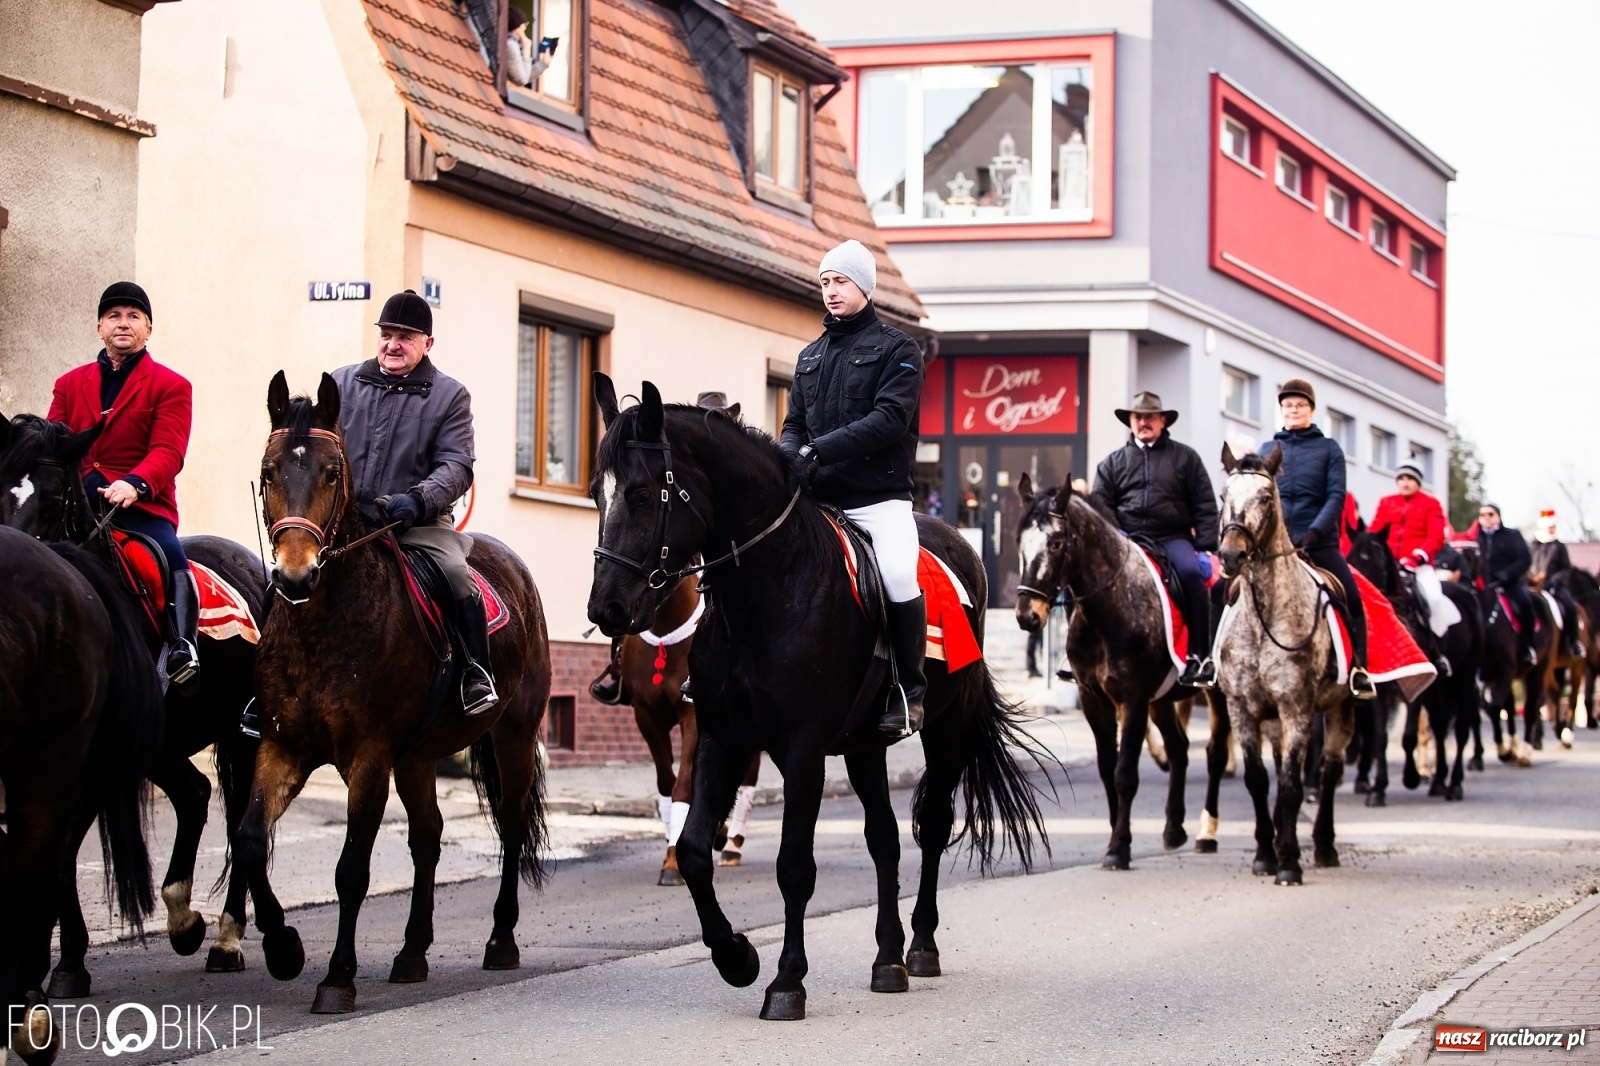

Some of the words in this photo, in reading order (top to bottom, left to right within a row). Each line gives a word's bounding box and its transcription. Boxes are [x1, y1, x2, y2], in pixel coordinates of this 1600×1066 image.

[963, 364, 1041, 398] Dom
[963, 406, 975, 430] i
[985, 386, 1067, 432] Ogród
